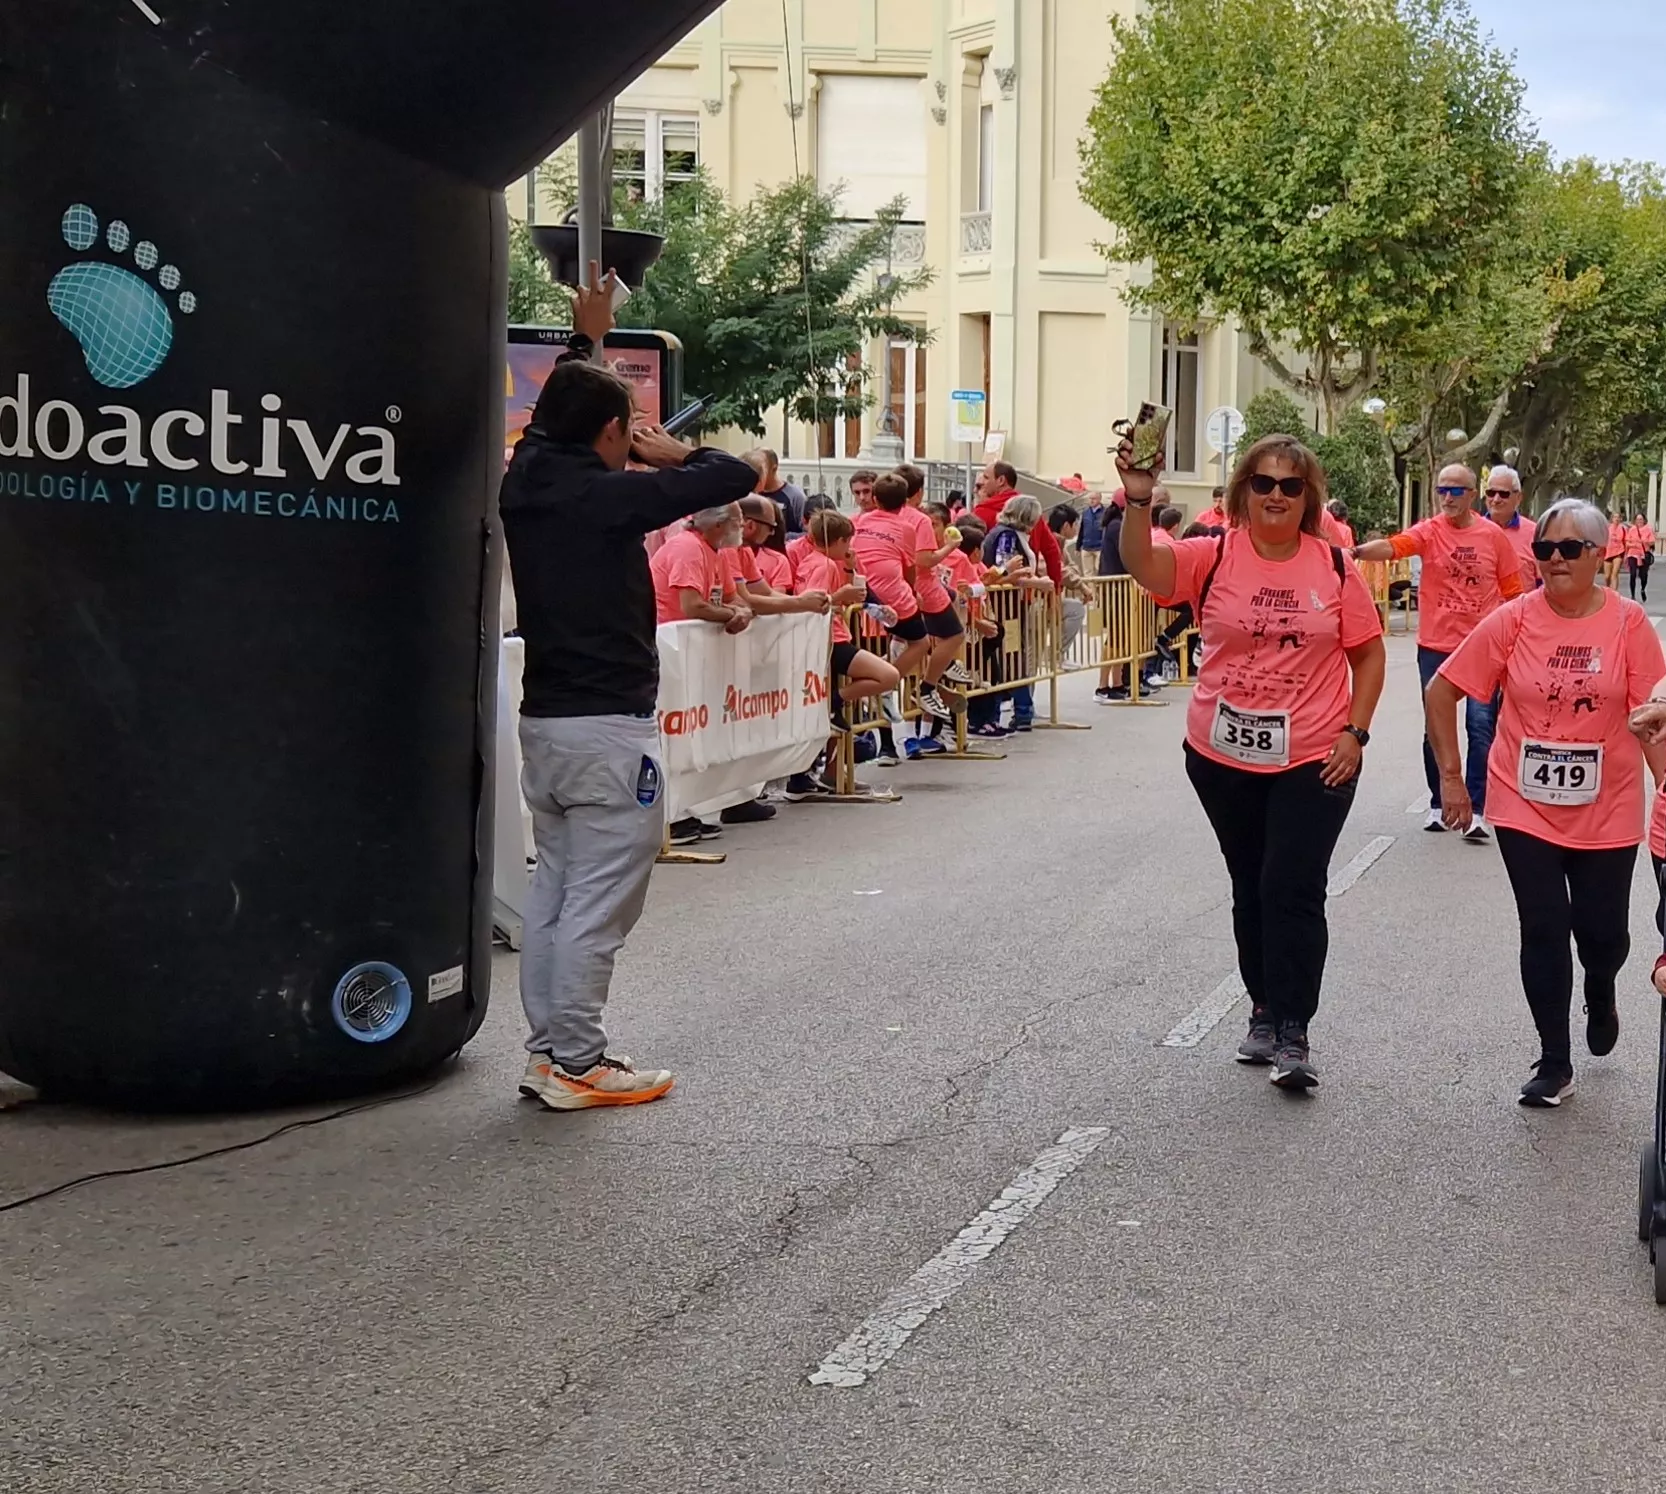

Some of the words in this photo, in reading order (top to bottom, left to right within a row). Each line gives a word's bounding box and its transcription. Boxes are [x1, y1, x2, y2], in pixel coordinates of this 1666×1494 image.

[0, 470, 111, 504] OLOGÍA
[125, 480, 142, 505] Y
[157, 484, 400, 523] BIOMECÁNICA
[722, 684, 788, 724] Alcampo
[1224, 722, 1273, 751] 358
[1533, 763, 1586, 788] 419
